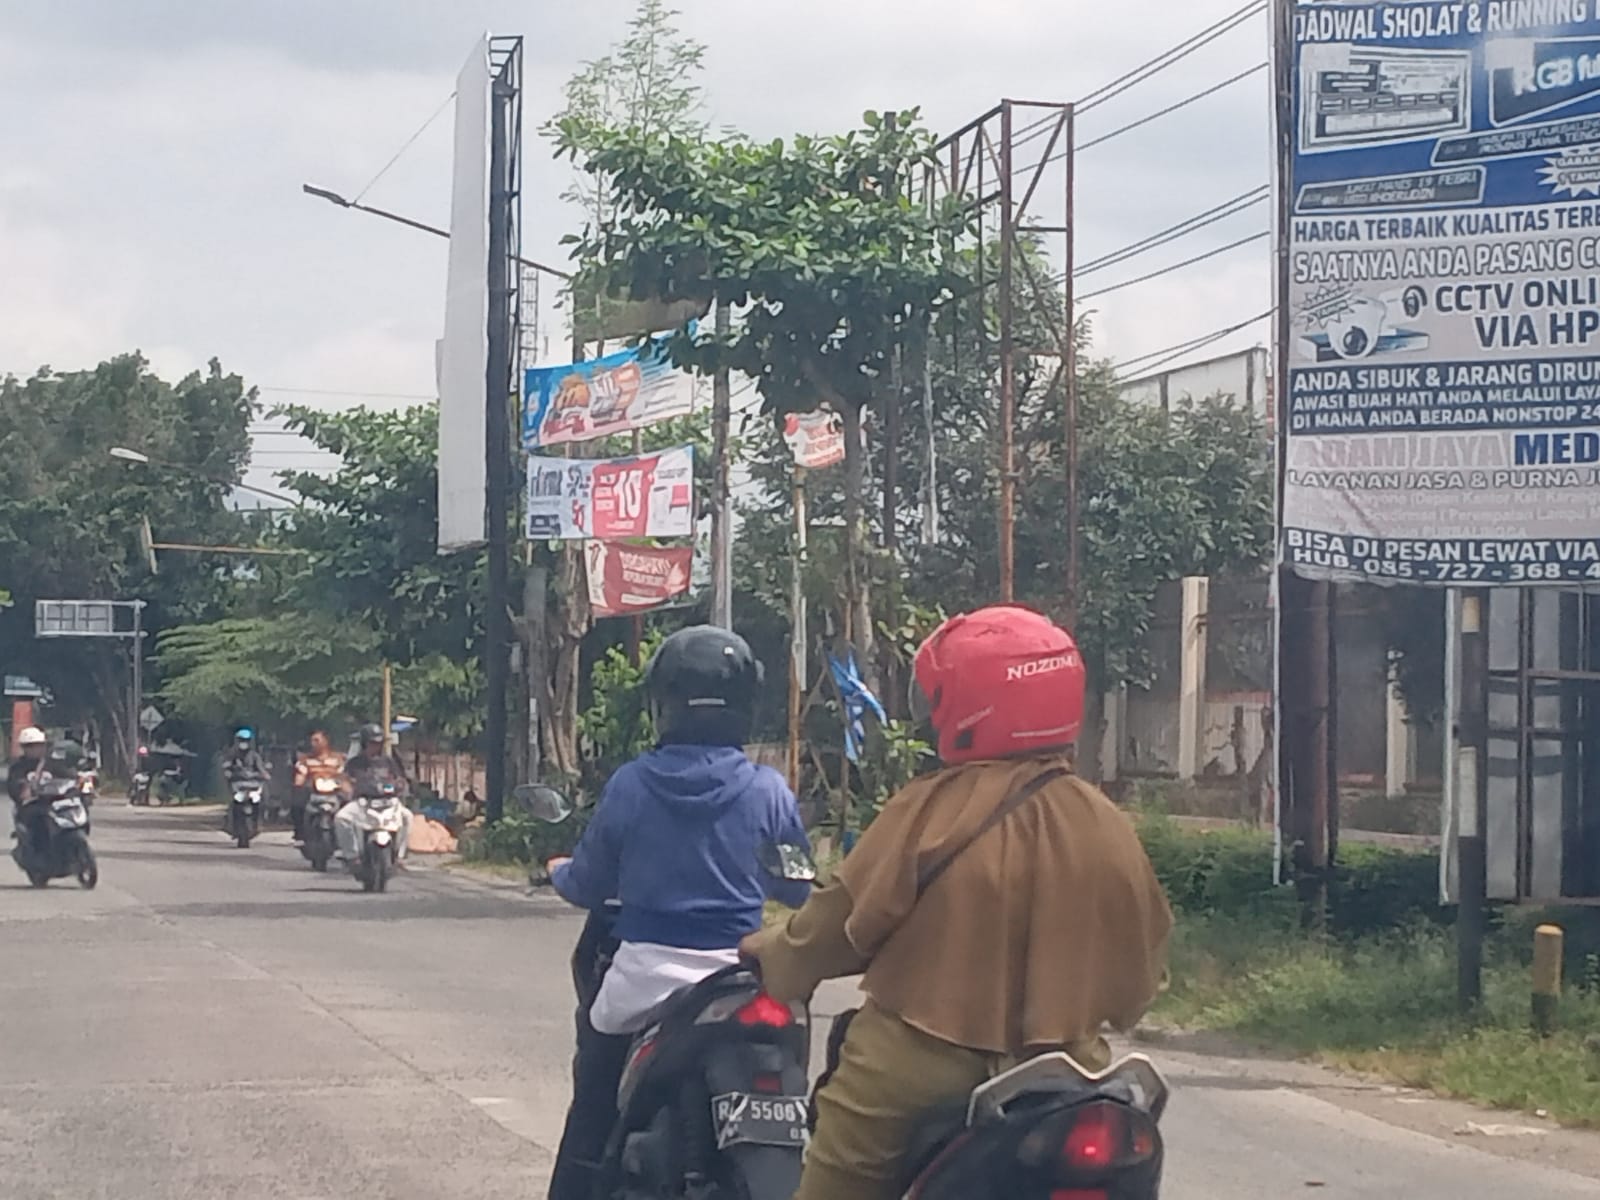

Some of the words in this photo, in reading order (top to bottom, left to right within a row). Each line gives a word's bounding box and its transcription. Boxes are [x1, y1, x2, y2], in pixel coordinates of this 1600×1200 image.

[1297, 9, 1377, 41] JADWAL
[1382, 5, 1463, 38] SHOLAT
[1467, 3, 1482, 33] &
[1488, 0, 1586, 32] RUNNING
[1295, 220, 1360, 242] HARGA
[1365, 215, 1448, 240] TERBAIK
[1453, 209, 1549, 236] KUALITAS
[1295, 249, 1397, 283] SAATNYA
[1401, 246, 1469, 277] ANDA
[1475, 239, 1573, 275] PASANG
[1436, 282, 1514, 312] CCTV
[1475, 314, 1538, 348] VIA
[1549, 311, 1600, 345] HP
[1294, 370, 1352, 392] ANDA
[1356, 367, 1420, 389] SIBUK
[1425, 367, 1440, 387] &
[1445, 363, 1532, 386] JARANG
[1294, 395, 1344, 411] AWASI
[1348, 392, 1392, 409] BUAH
[1396, 391, 1433, 406] HATI
[1437, 389, 1484, 404] ANDA
[1487, 386, 1561, 403] MELALUI
[1293, 414, 1310, 429] DI
[1315, 411, 1365, 427] MANA
[1368, 410, 1416, 426] ANDA
[1420, 407, 1489, 425] BERADA
[1493, 405, 1577, 422] NONSTOP
[1514, 432, 1600, 465] MED
[1289, 469, 1400, 490] LAYANAN
[1405, 472, 1463, 489] JASA
[1470, 471, 1487, 489] &
[1494, 469, 1580, 489] PURNA
[1287, 529, 1346, 554] BISA
[1352, 538, 1378, 558] DI
[1385, 541, 1461, 562] PESAN
[1468, 541, 1549, 562] LEWAT
[1555, 541, 1600, 561] VIA
[1363, 559, 1412, 577] 085
[1435, 562, 1485, 580] 727
[1509, 562, 1561, 580] 368
